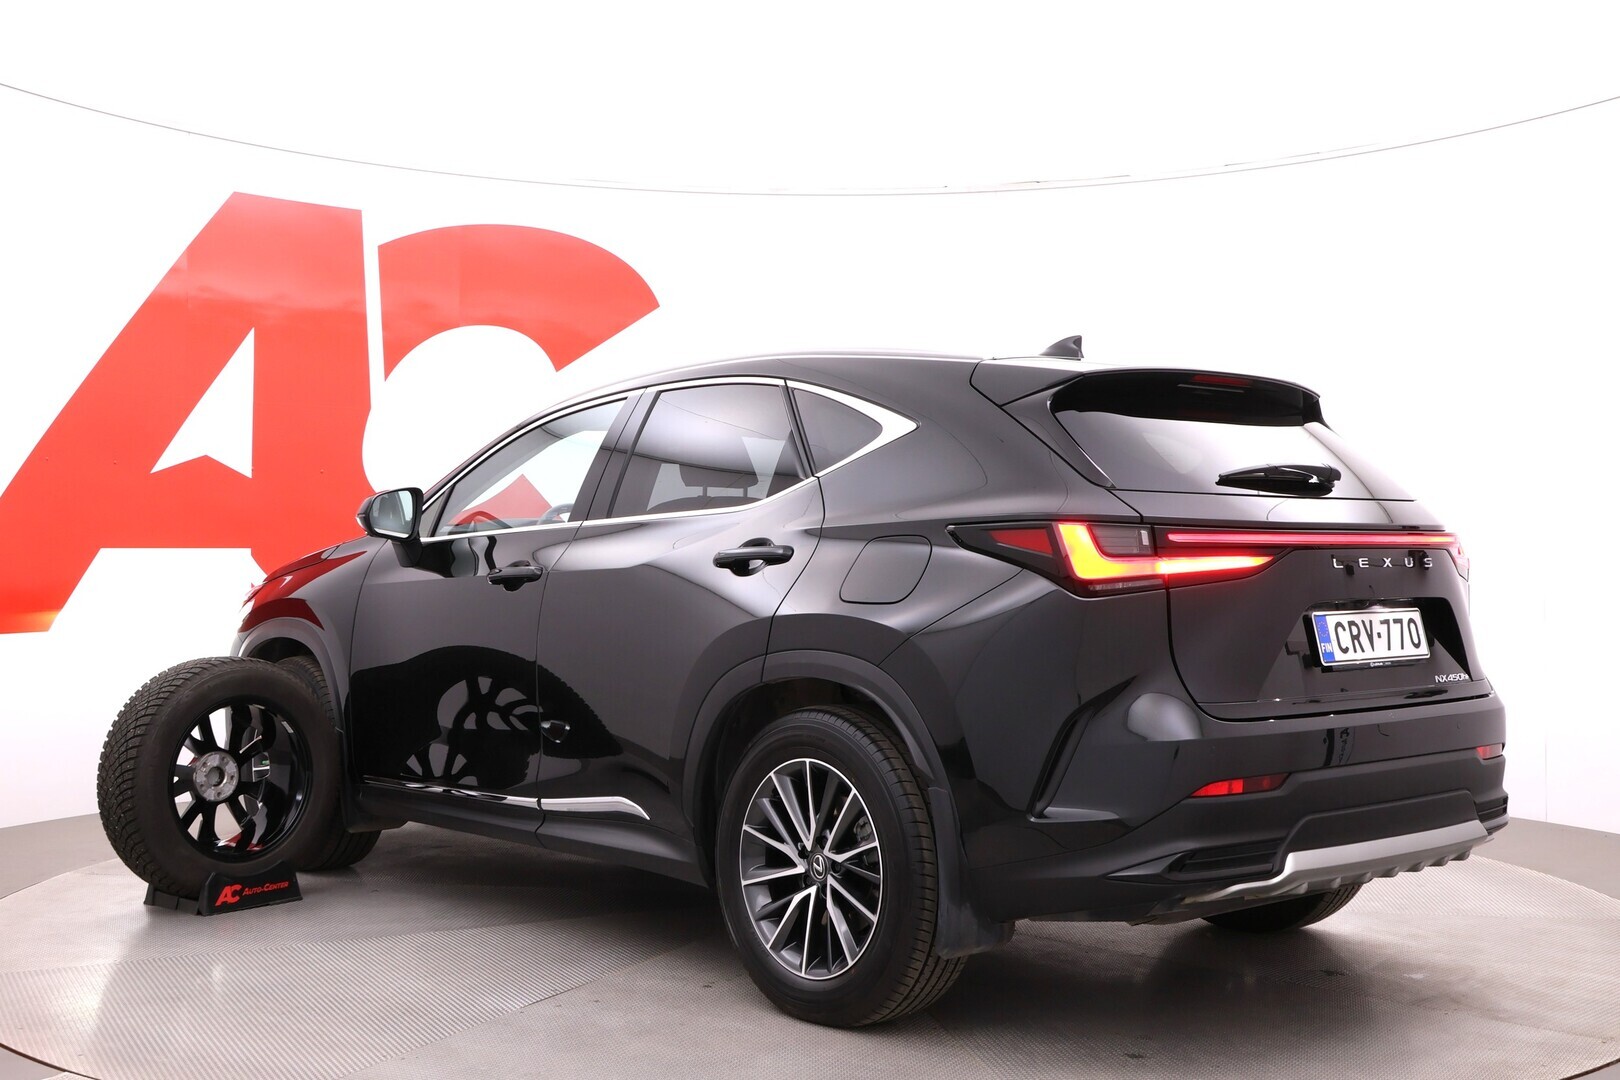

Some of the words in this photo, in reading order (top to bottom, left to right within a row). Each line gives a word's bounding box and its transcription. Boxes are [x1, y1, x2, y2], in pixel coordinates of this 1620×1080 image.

[1332, 557, 1433, 569] LEXUS
[1334, 617, 1422, 654] CRV-770
[1321, 642, 1334, 653] FIN
[215, 884, 242, 906] AC
